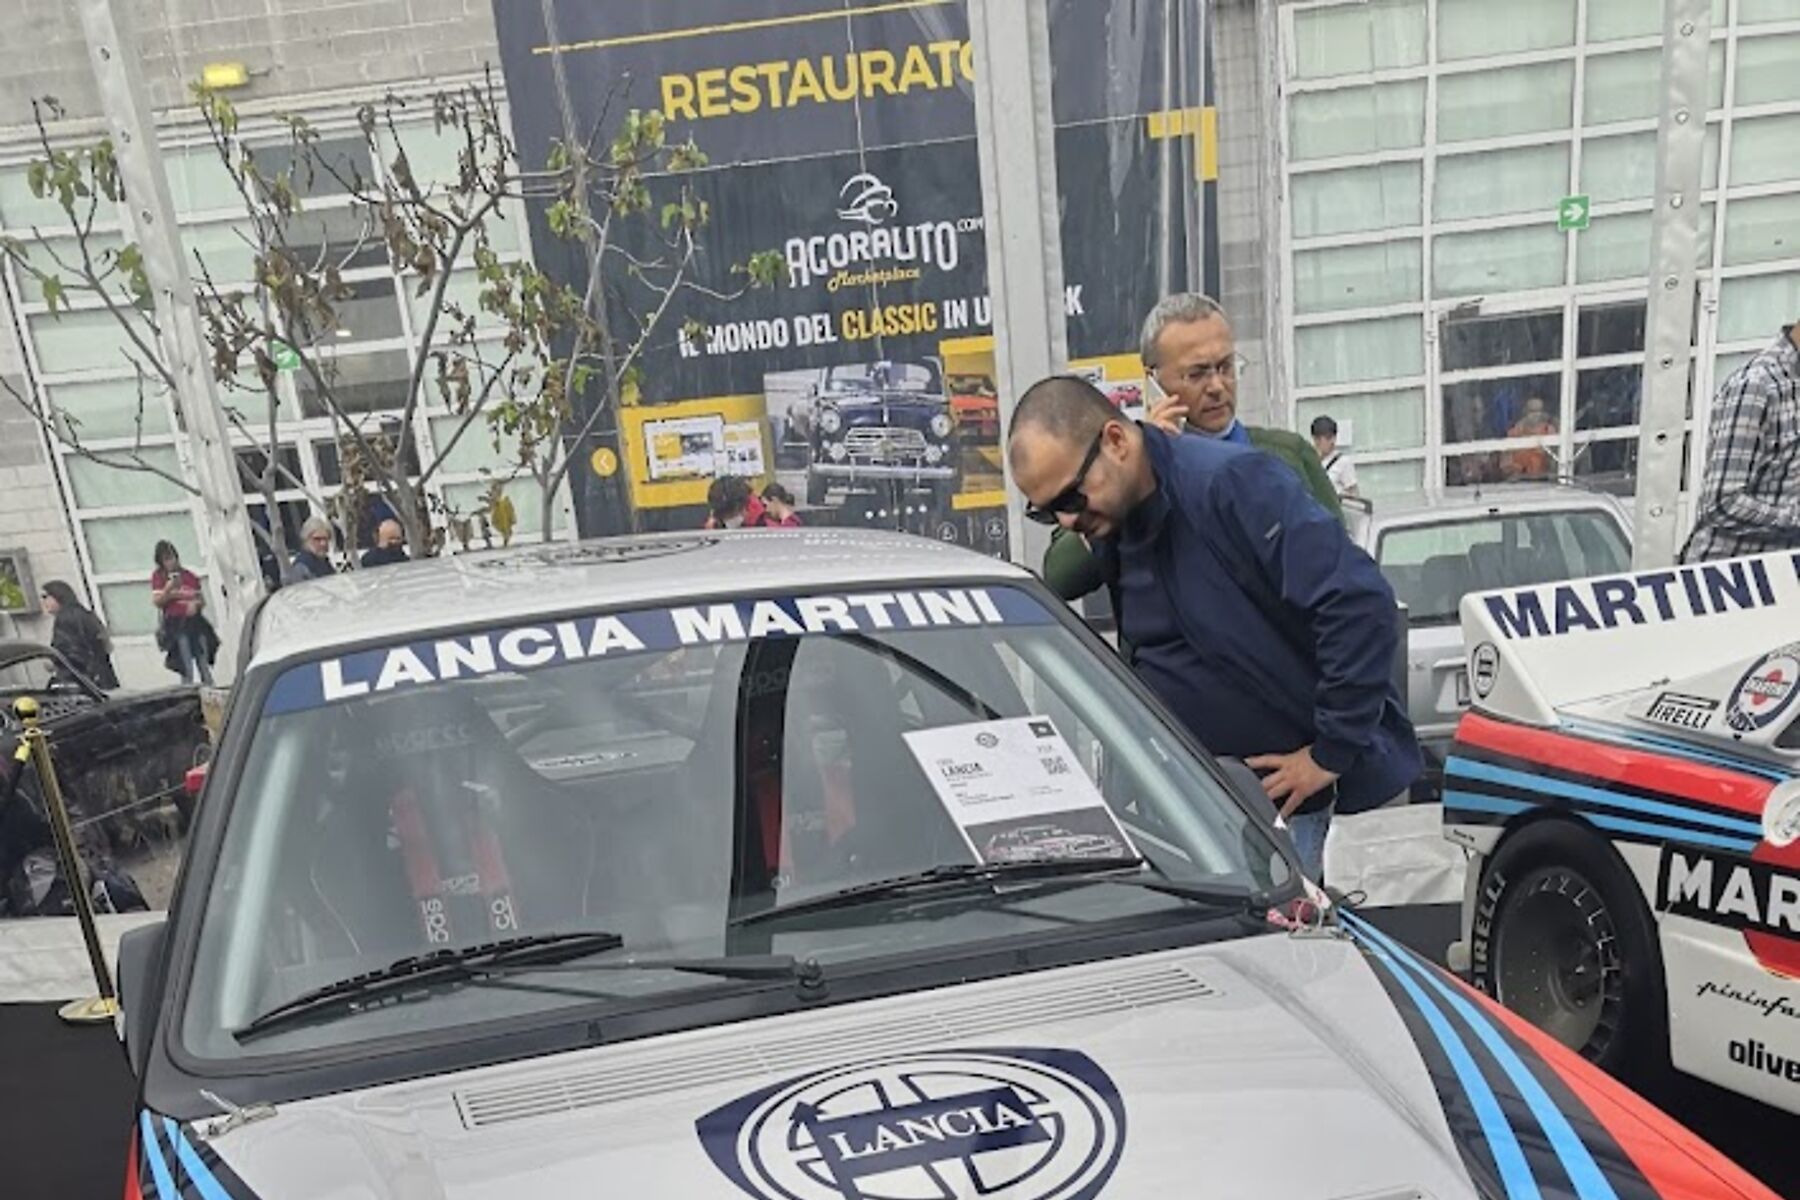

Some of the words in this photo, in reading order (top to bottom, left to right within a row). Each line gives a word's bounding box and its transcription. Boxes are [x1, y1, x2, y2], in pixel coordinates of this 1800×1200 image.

[786, 221, 958, 288] AGORAUTO
[706, 316, 790, 355] MONDO
[794, 312, 838, 347] DEL
[841, 302, 938, 340] CLASSIC
[943, 298, 968, 329] IN
[1482, 559, 1777, 640] MARTINI
[320, 616, 646, 700] LANCIA
[670, 589, 1003, 645] MARTINI
[829, 1101, 1034, 1160] LANCIA
